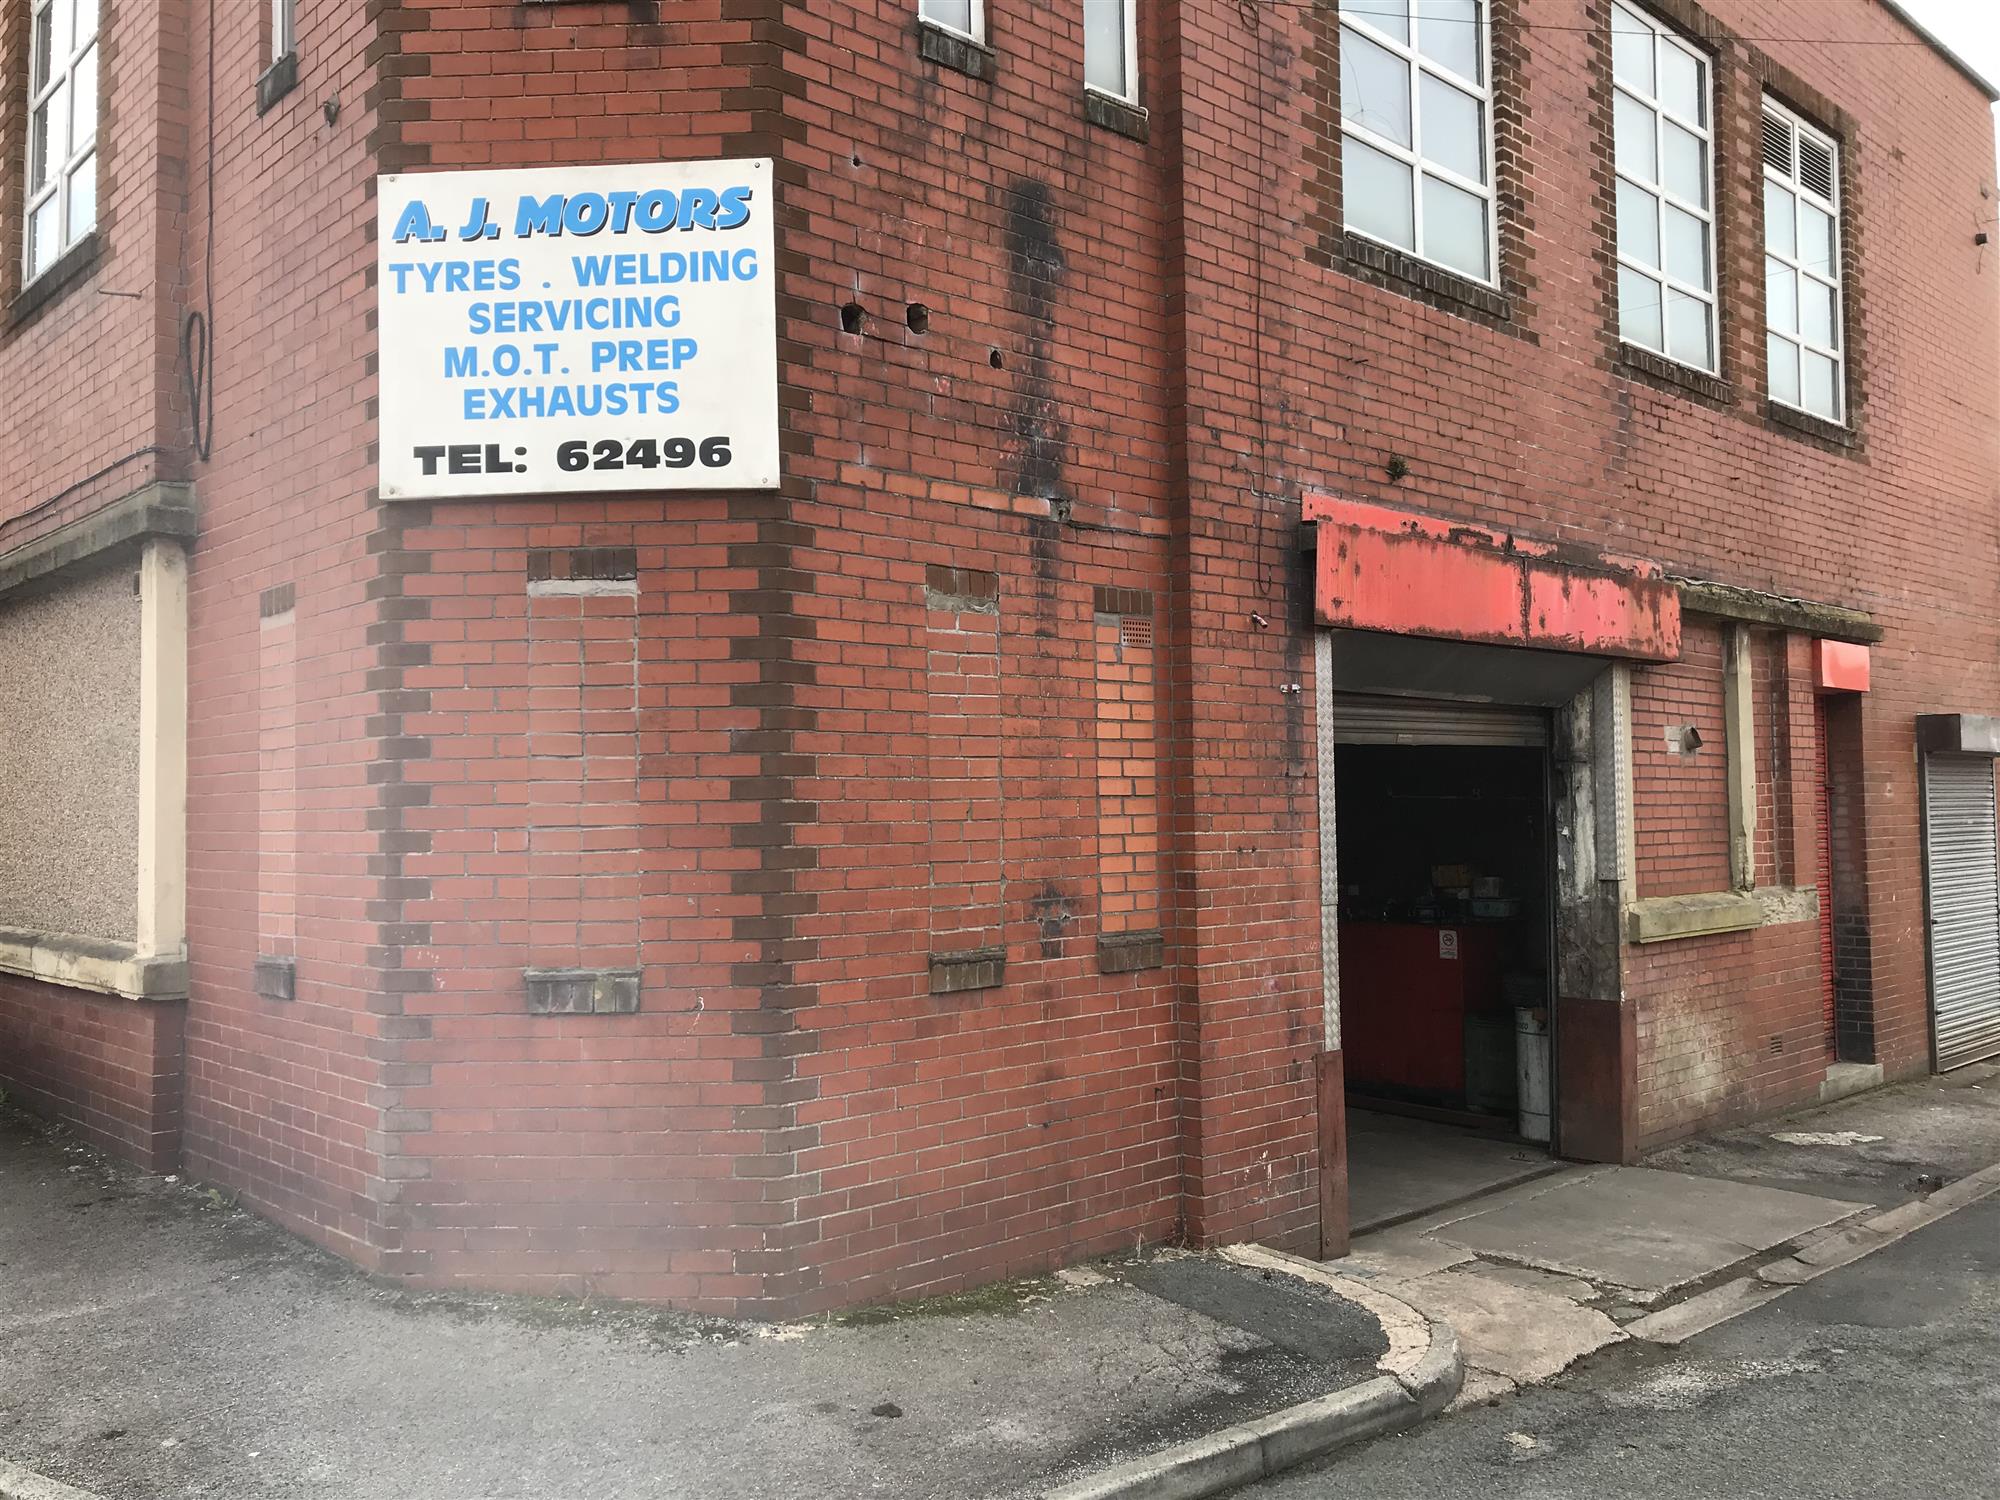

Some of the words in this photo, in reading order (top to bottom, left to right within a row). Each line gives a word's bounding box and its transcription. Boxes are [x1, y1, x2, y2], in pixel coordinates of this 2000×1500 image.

[392, 200, 447, 243] A.
[458, 197, 502, 242] J.
[514, 186, 753, 239] MOTORS
[388, 258, 521, 294] TYRES
[571, 248, 758, 288] WELDING
[468, 294, 681, 335] SERVICING
[444, 343, 569, 378] M.O.T.
[592, 338, 698, 373] PREP
[463, 381, 680, 420] EXHAUSTS
[413, 444, 528, 476] TEL:
[556, 436, 732, 472] 62496
